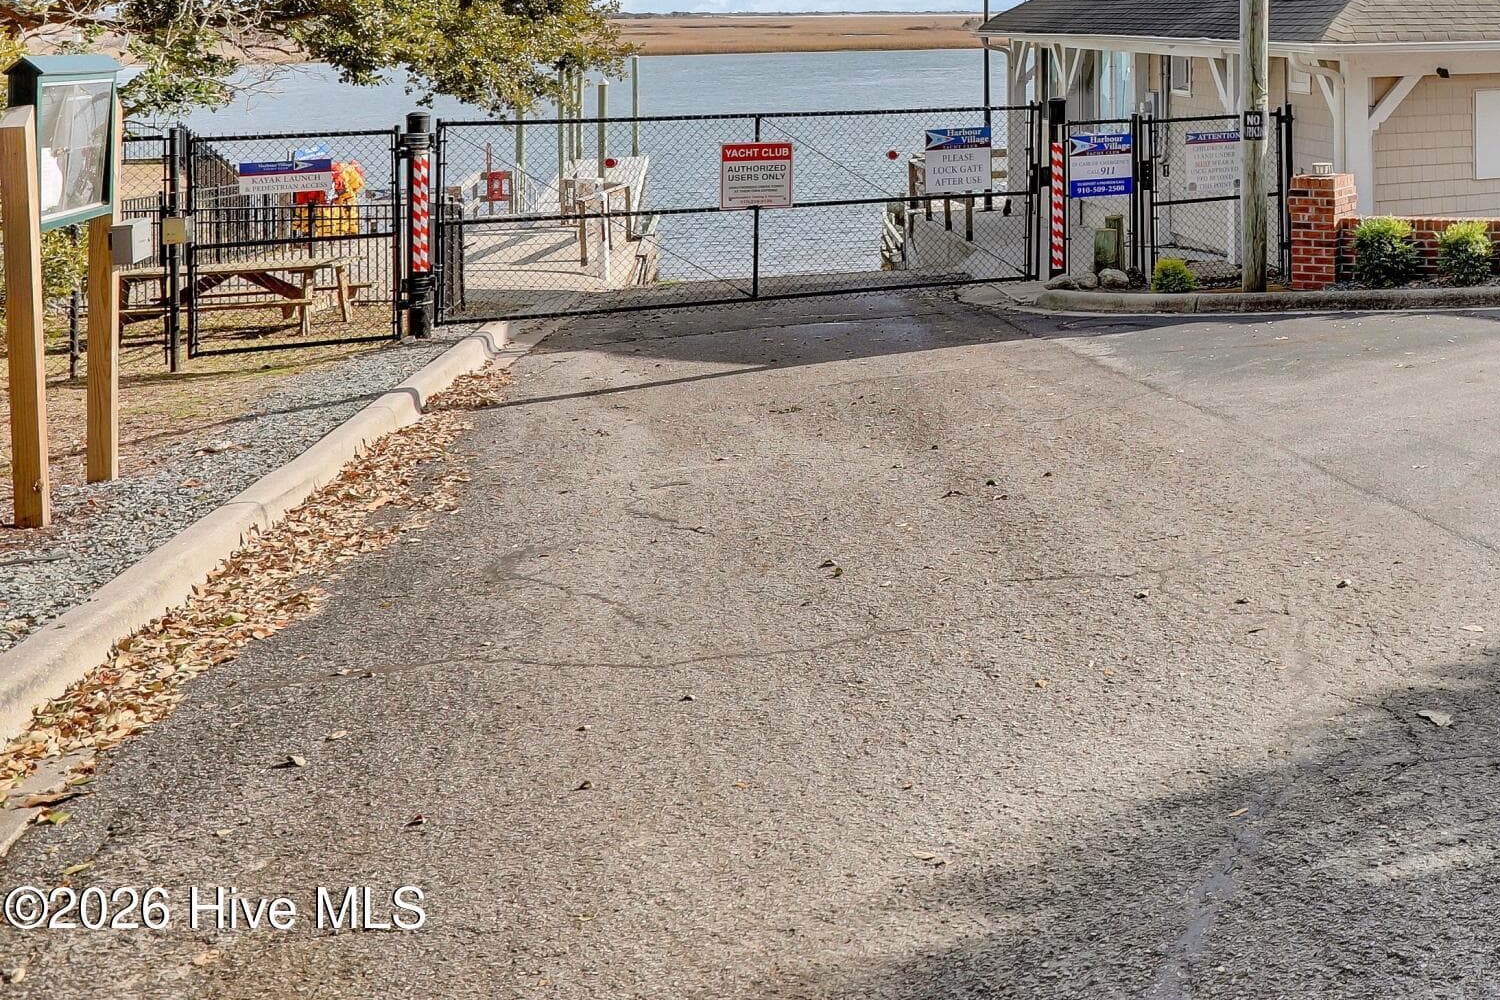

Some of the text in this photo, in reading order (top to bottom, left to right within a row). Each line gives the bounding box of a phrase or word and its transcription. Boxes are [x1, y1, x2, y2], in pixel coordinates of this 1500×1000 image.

[1246, 114, 1260, 126] NO
[947, 129, 982, 137] Harbour
[1198, 133, 1240, 141] ATTENTION
[961, 136, 990, 144] Village
[1090, 136, 1123, 144] Harbour
[1104, 142, 1131, 151] Village
[725, 148, 789, 158] YACHT CLUB
[942, 153, 974, 162] PLEASE
[728, 165, 787, 173] AUTHORIZED
[932, 164, 984, 175] LOCK GATE
[1100, 167, 1115, 175] 911
[252, 174, 321, 185] KAYAK LAUNCH
[728, 174, 759, 182] USERS
[935, 176, 983, 187] AFTER USE
